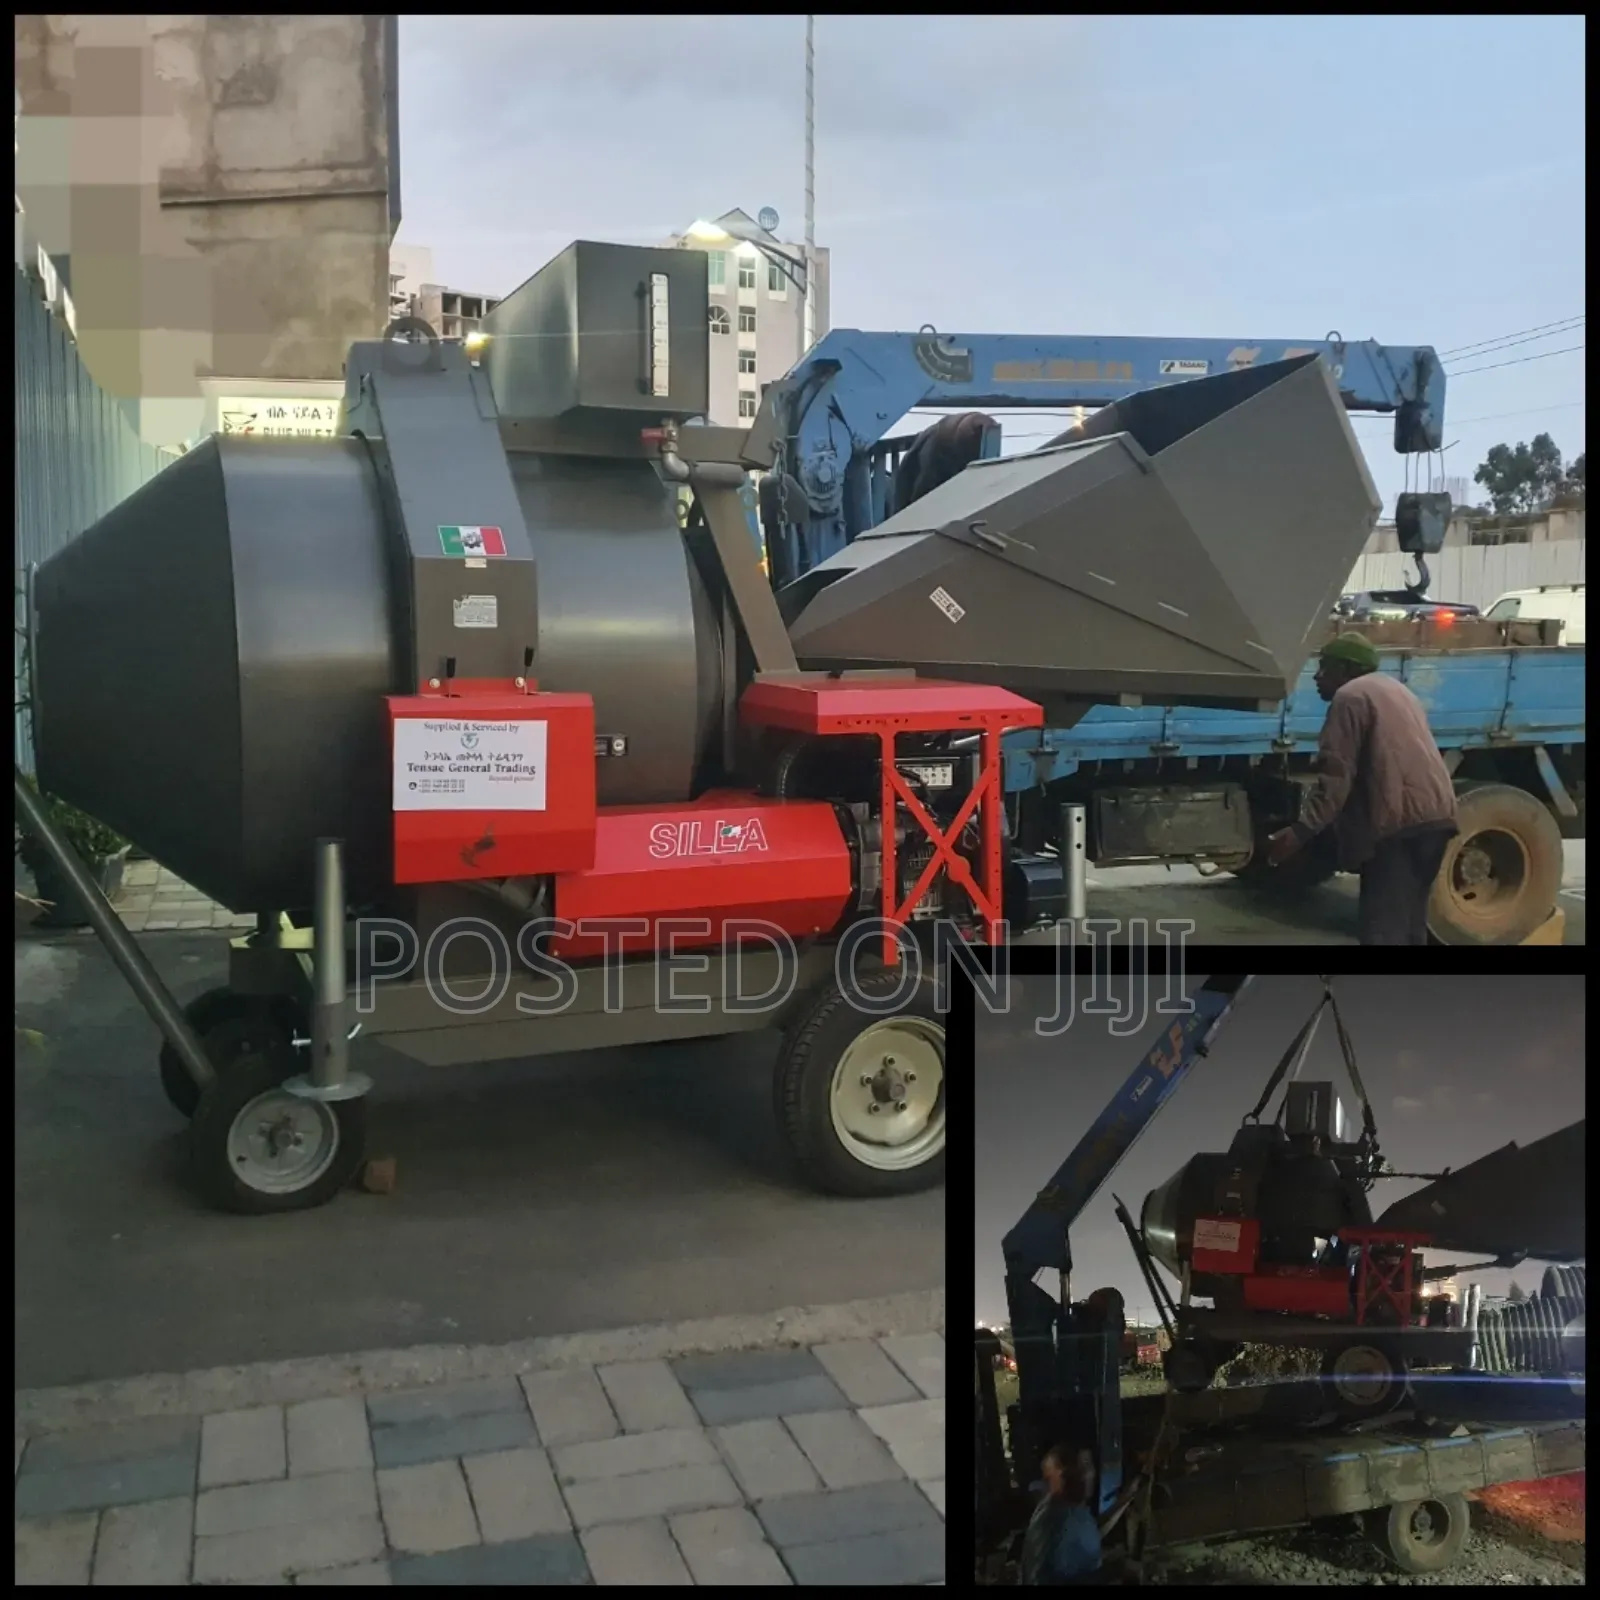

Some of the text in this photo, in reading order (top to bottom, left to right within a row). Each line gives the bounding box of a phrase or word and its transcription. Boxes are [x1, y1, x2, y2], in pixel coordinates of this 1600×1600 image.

[424, 722, 461, 733] Supplied
[472, 722, 508, 732] Serviced
[509, 723, 520, 735] by
[407, 762, 536, 776] Tensae General Trading
[648, 817, 768, 859] SILLA
